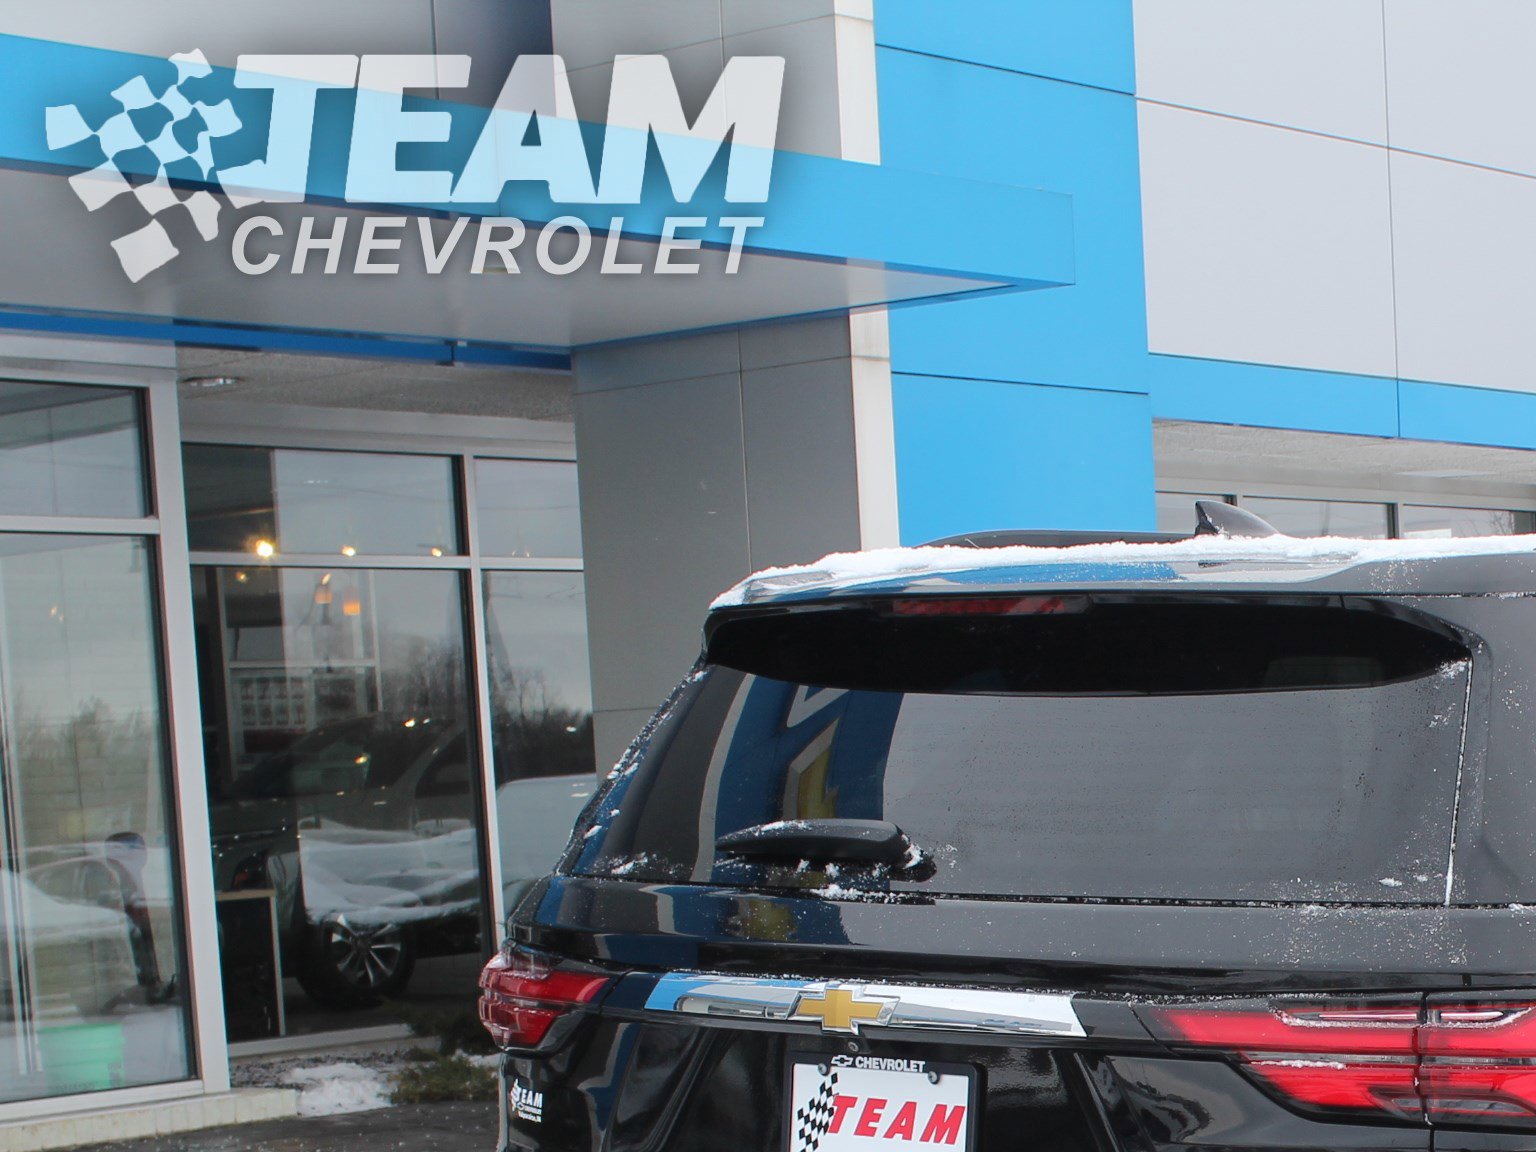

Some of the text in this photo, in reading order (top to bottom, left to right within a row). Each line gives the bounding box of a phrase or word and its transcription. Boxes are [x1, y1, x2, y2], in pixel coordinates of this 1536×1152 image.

[855, 1056, 925, 1073] CHEVROLET
[516, 1086, 543, 1108] TEAM
[827, 1094, 966, 1145] TEAM
